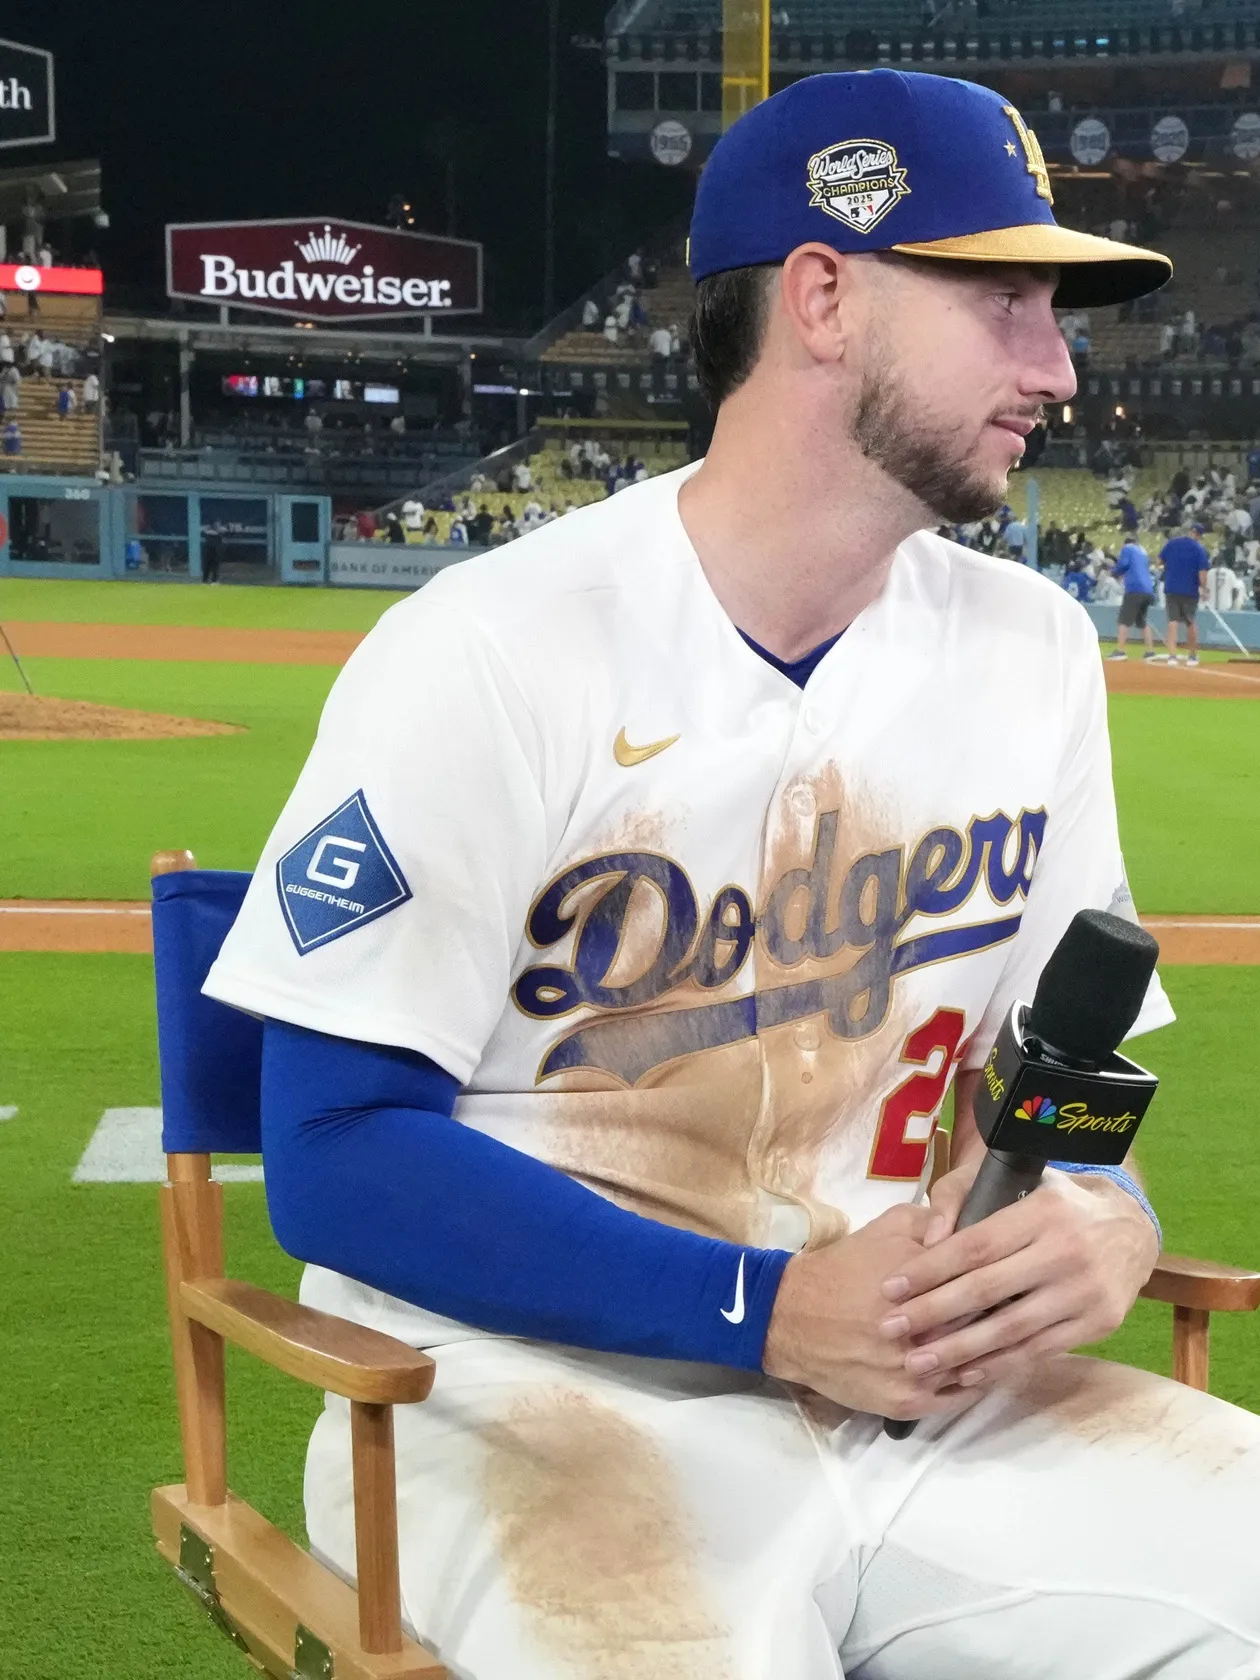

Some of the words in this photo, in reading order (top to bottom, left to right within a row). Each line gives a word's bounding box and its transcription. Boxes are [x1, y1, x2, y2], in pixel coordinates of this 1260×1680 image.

[810, 153, 857, 179] World
[850, 149, 894, 180] Series
[822, 178, 895, 197] CHAMPIONS
[847, 193, 873, 205] 2025
[331, 562, 367, 573] BANK
[371, 563, 388, 574] OF
[392, 564, 442, 576] AMERIC
[306, 834, 367, 889] G
[286, 883, 365, 914] GUGGENHEIM
[512, 803, 1049, 1042] Dodgers
[866, 1005, 968, 1182] 2
[1056, 1102, 1137, 1135] Sports
